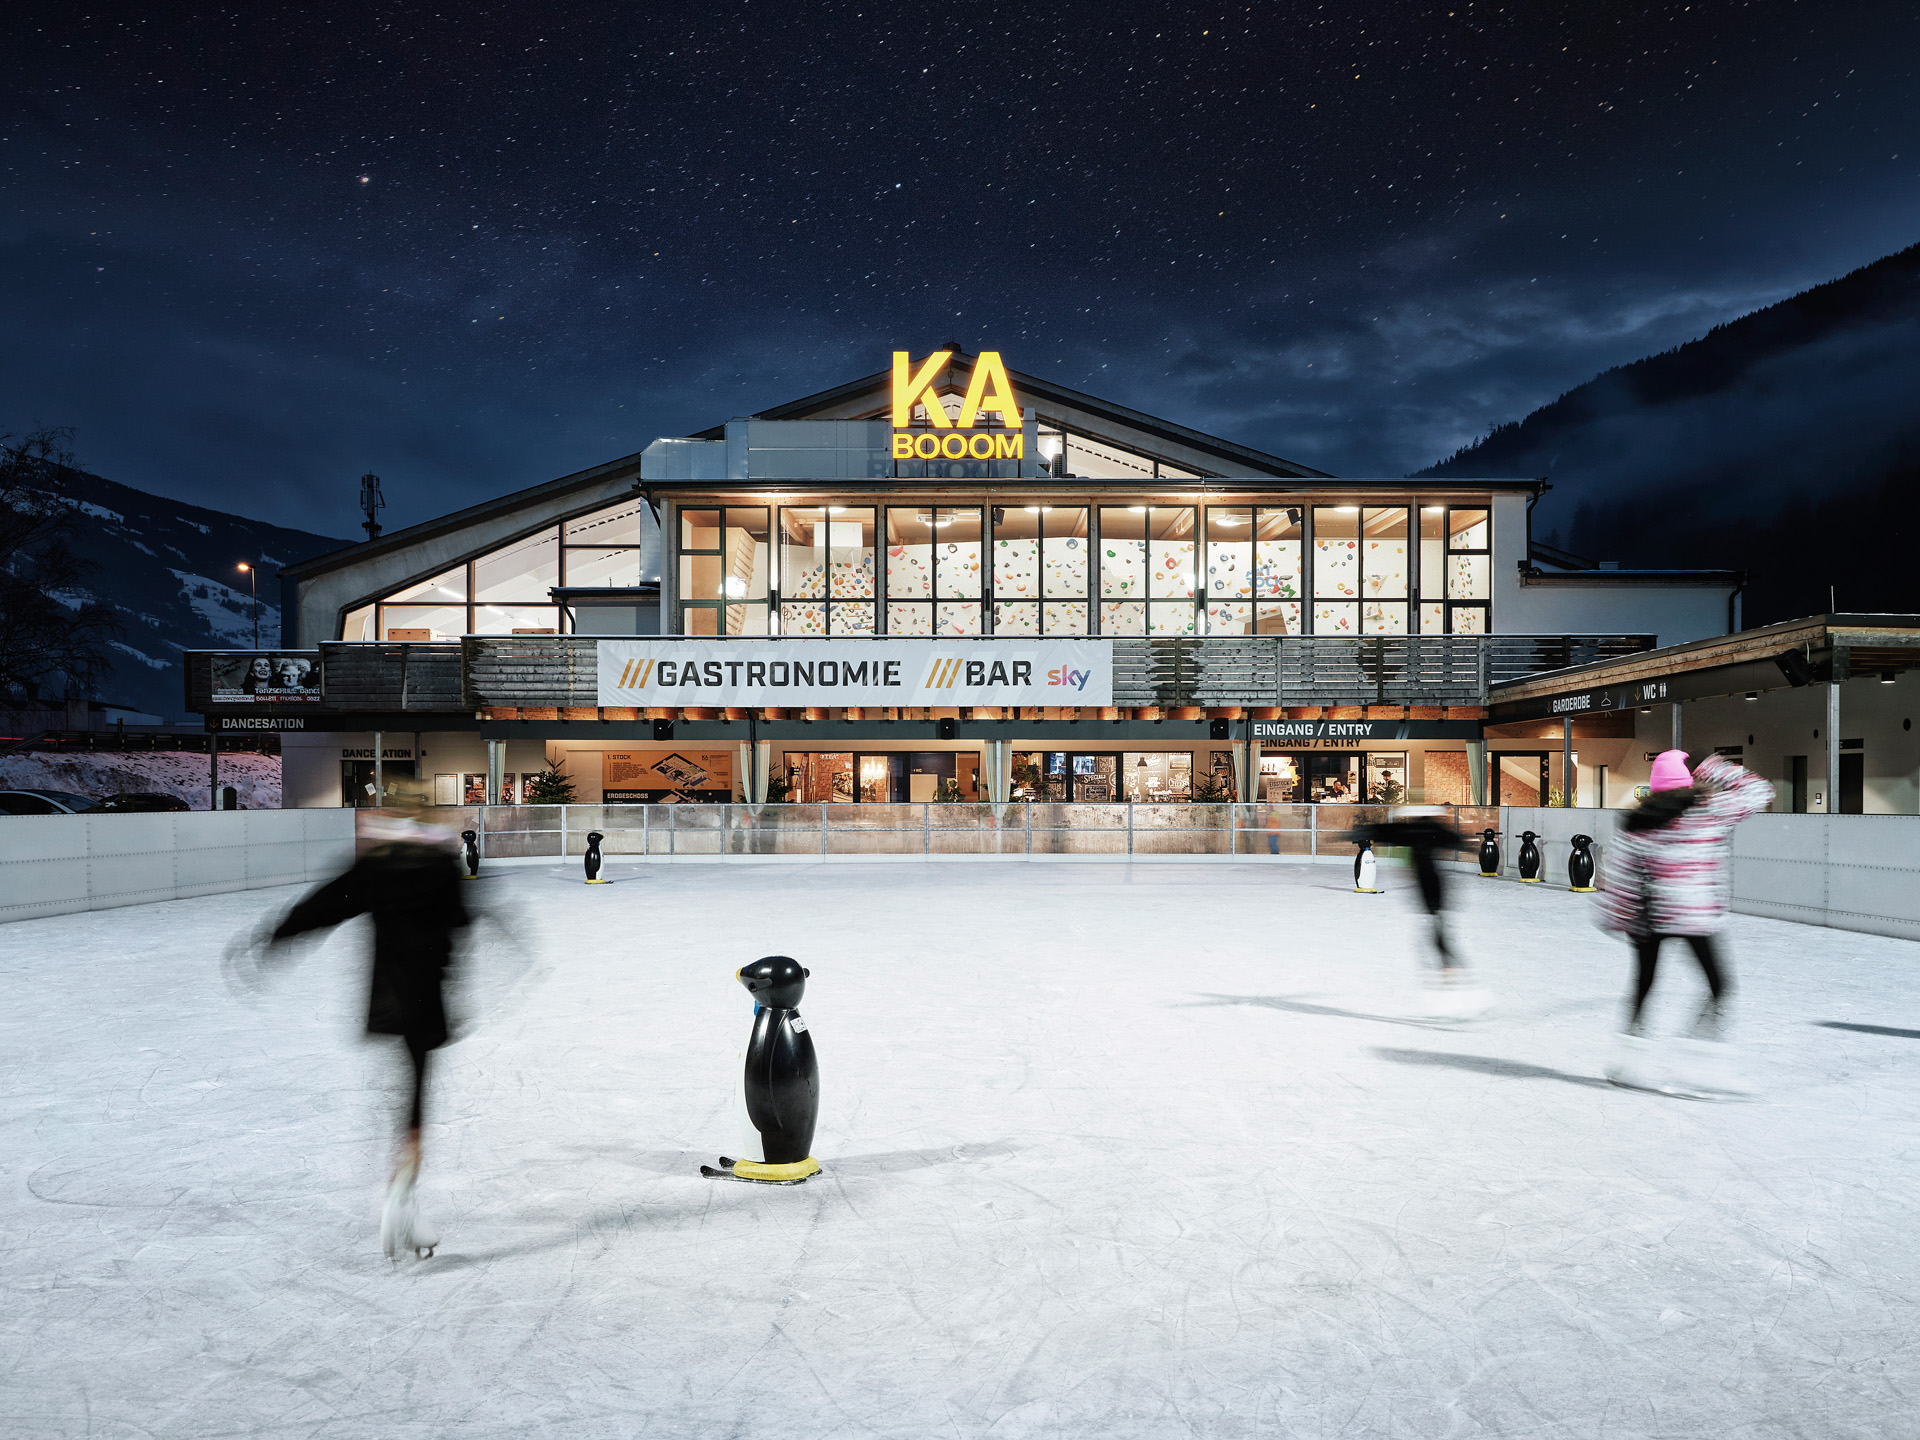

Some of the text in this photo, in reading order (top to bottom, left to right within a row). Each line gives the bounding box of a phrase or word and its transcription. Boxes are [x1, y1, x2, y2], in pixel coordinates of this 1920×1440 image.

[893, 351, 1023, 429] KA
[892, 433, 1024, 460] BOOOM
[657, 660, 1092, 691] GASTRONOMIE BAR sky
[1643, 683, 1656, 700] WC
[1552, 694, 1591, 713] GARDEROBE
[222, 718, 304, 729] DANCESATION
[1253, 722, 1373, 737] EINGANG / ENTRY
[1260, 738, 1310, 748] EINGANG
[1323, 738, 1361, 748] ENTRY
[342, 749, 411, 758] DANCEATION
